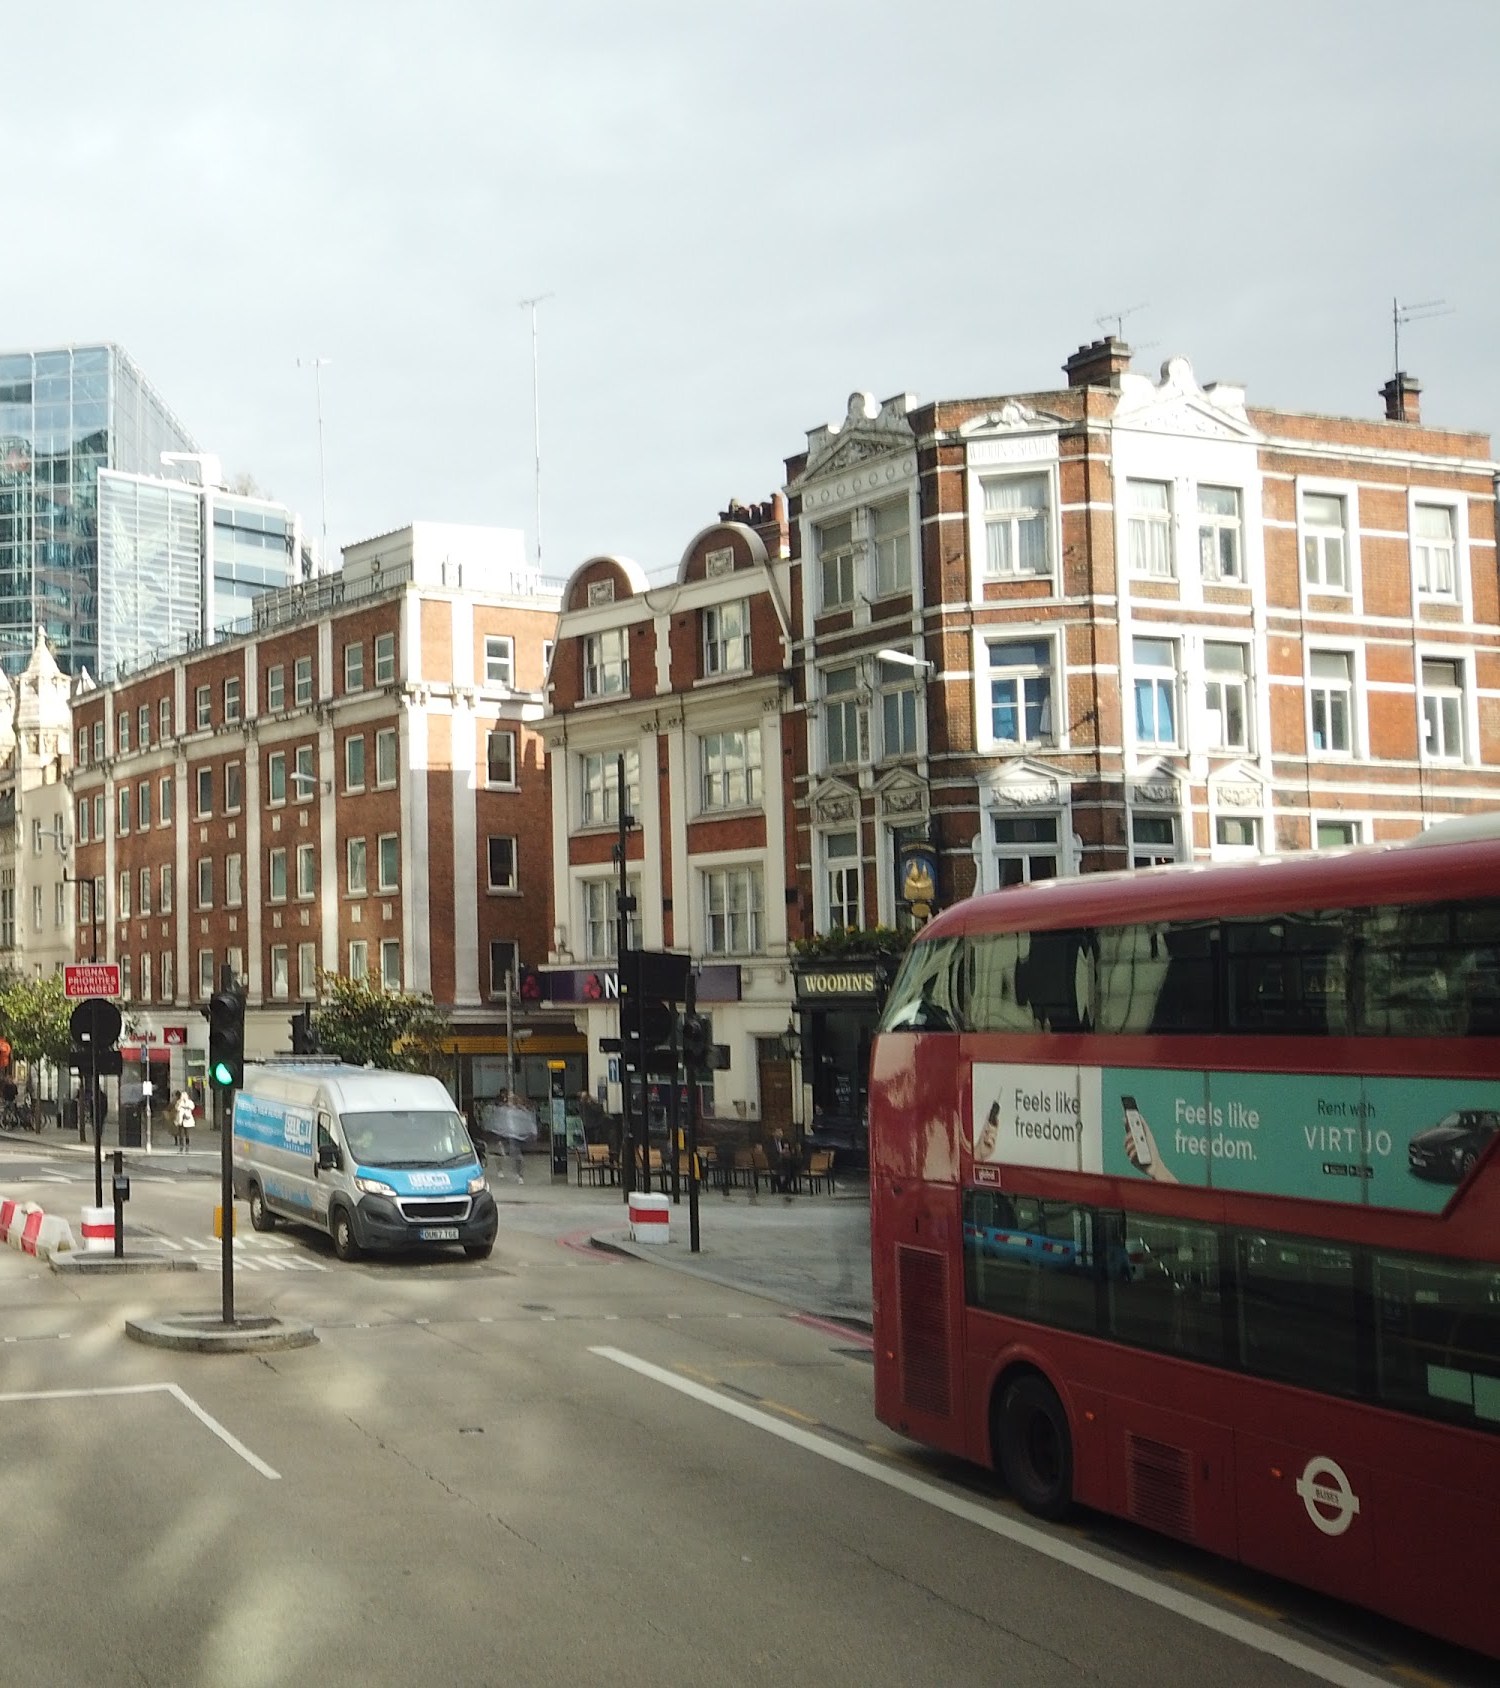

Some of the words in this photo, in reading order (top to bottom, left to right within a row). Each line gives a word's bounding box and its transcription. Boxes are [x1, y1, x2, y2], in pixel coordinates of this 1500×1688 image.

[68, 976, 116, 986] PRIORITIES
[75, 968, 109, 977] SIGNAL
[805, 973, 874, 992] WOODIN'S
[70, 985, 115, 994] CHANGED
[1015, 1089, 1051, 1112] Feels
[1055, 1090, 1081, 1115] like
[1317, 1099, 1347, 1117] Rent
[1350, 1102, 1376, 1118] with
[1175, 1098, 1223, 1127] Feels
[1228, 1102, 1260, 1130] like
[1015, 1116, 1083, 1143] freedom?
[1304, 1125, 1392, 1156] VIRTUO
[1175, 1128, 1258, 1161] freedom.
